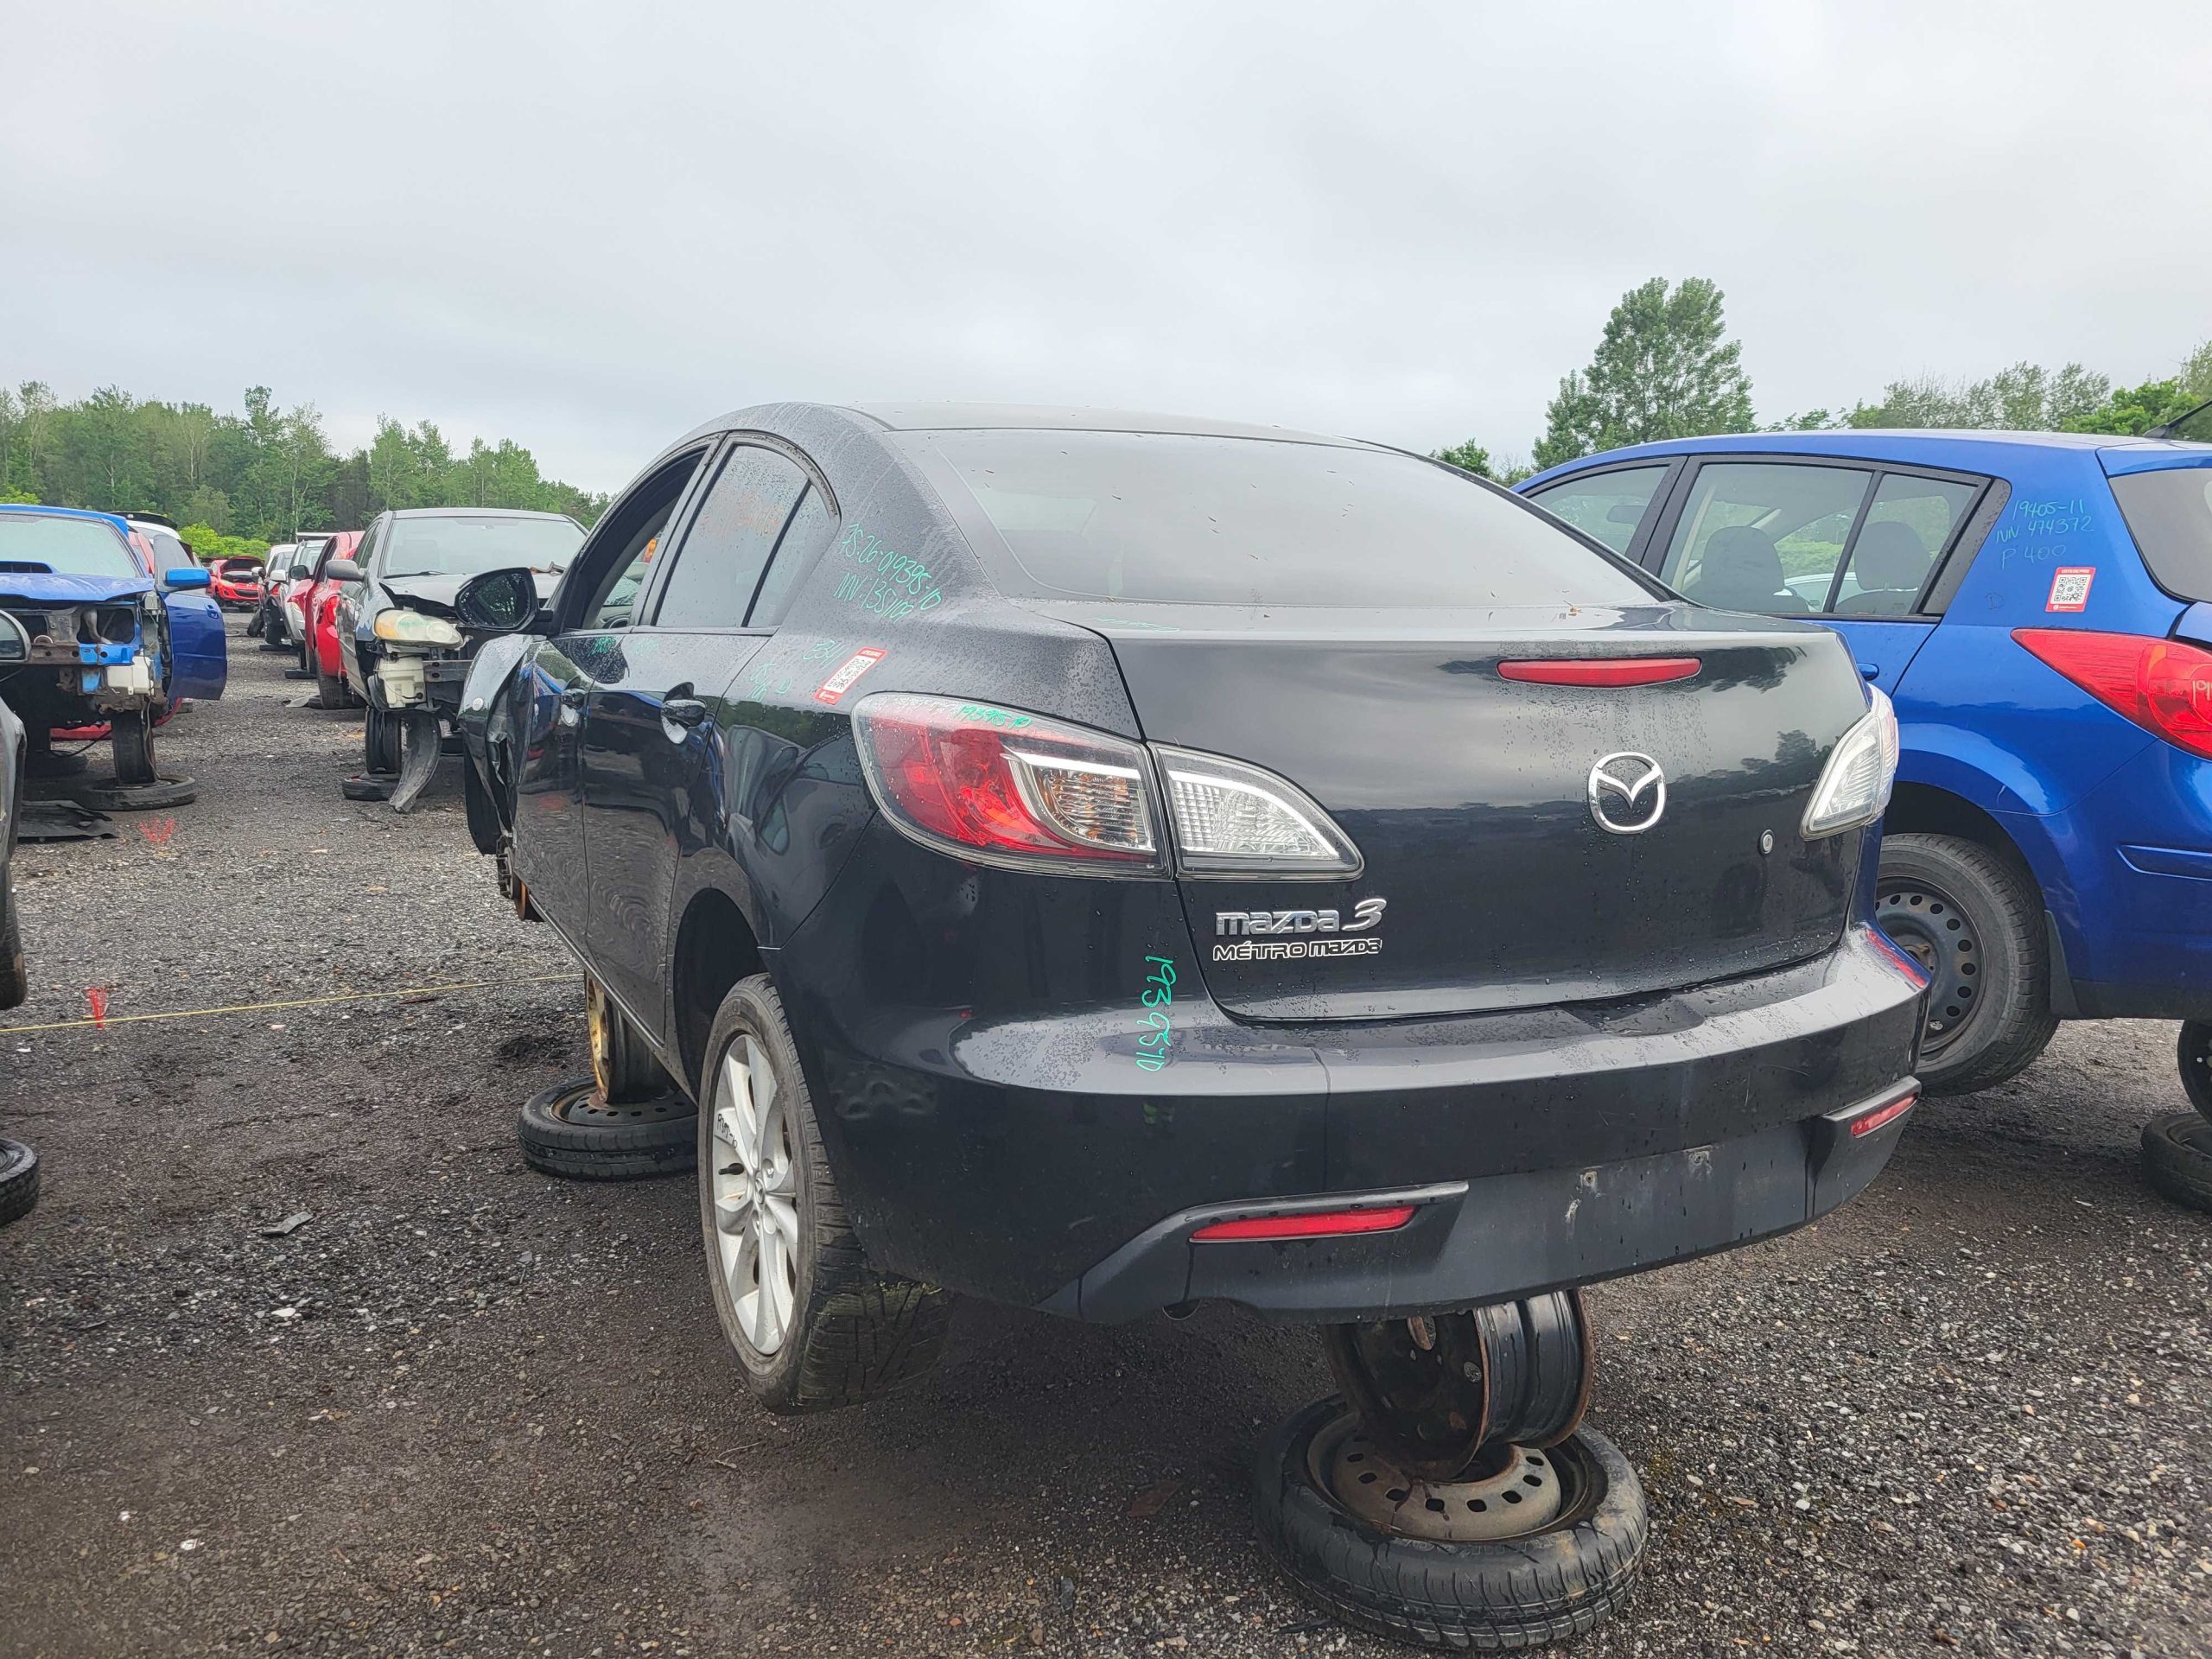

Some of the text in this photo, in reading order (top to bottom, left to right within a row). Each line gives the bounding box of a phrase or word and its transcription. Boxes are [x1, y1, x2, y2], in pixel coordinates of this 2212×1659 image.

[2012, 499, 2085, 520] 19405-11
[2028, 516, 2094, 537] 474372
[2002, 544, 2067, 569] P 400
[1215, 898, 1387, 936] mazda 3
[1212, 940, 1307, 962] MÉTRO
